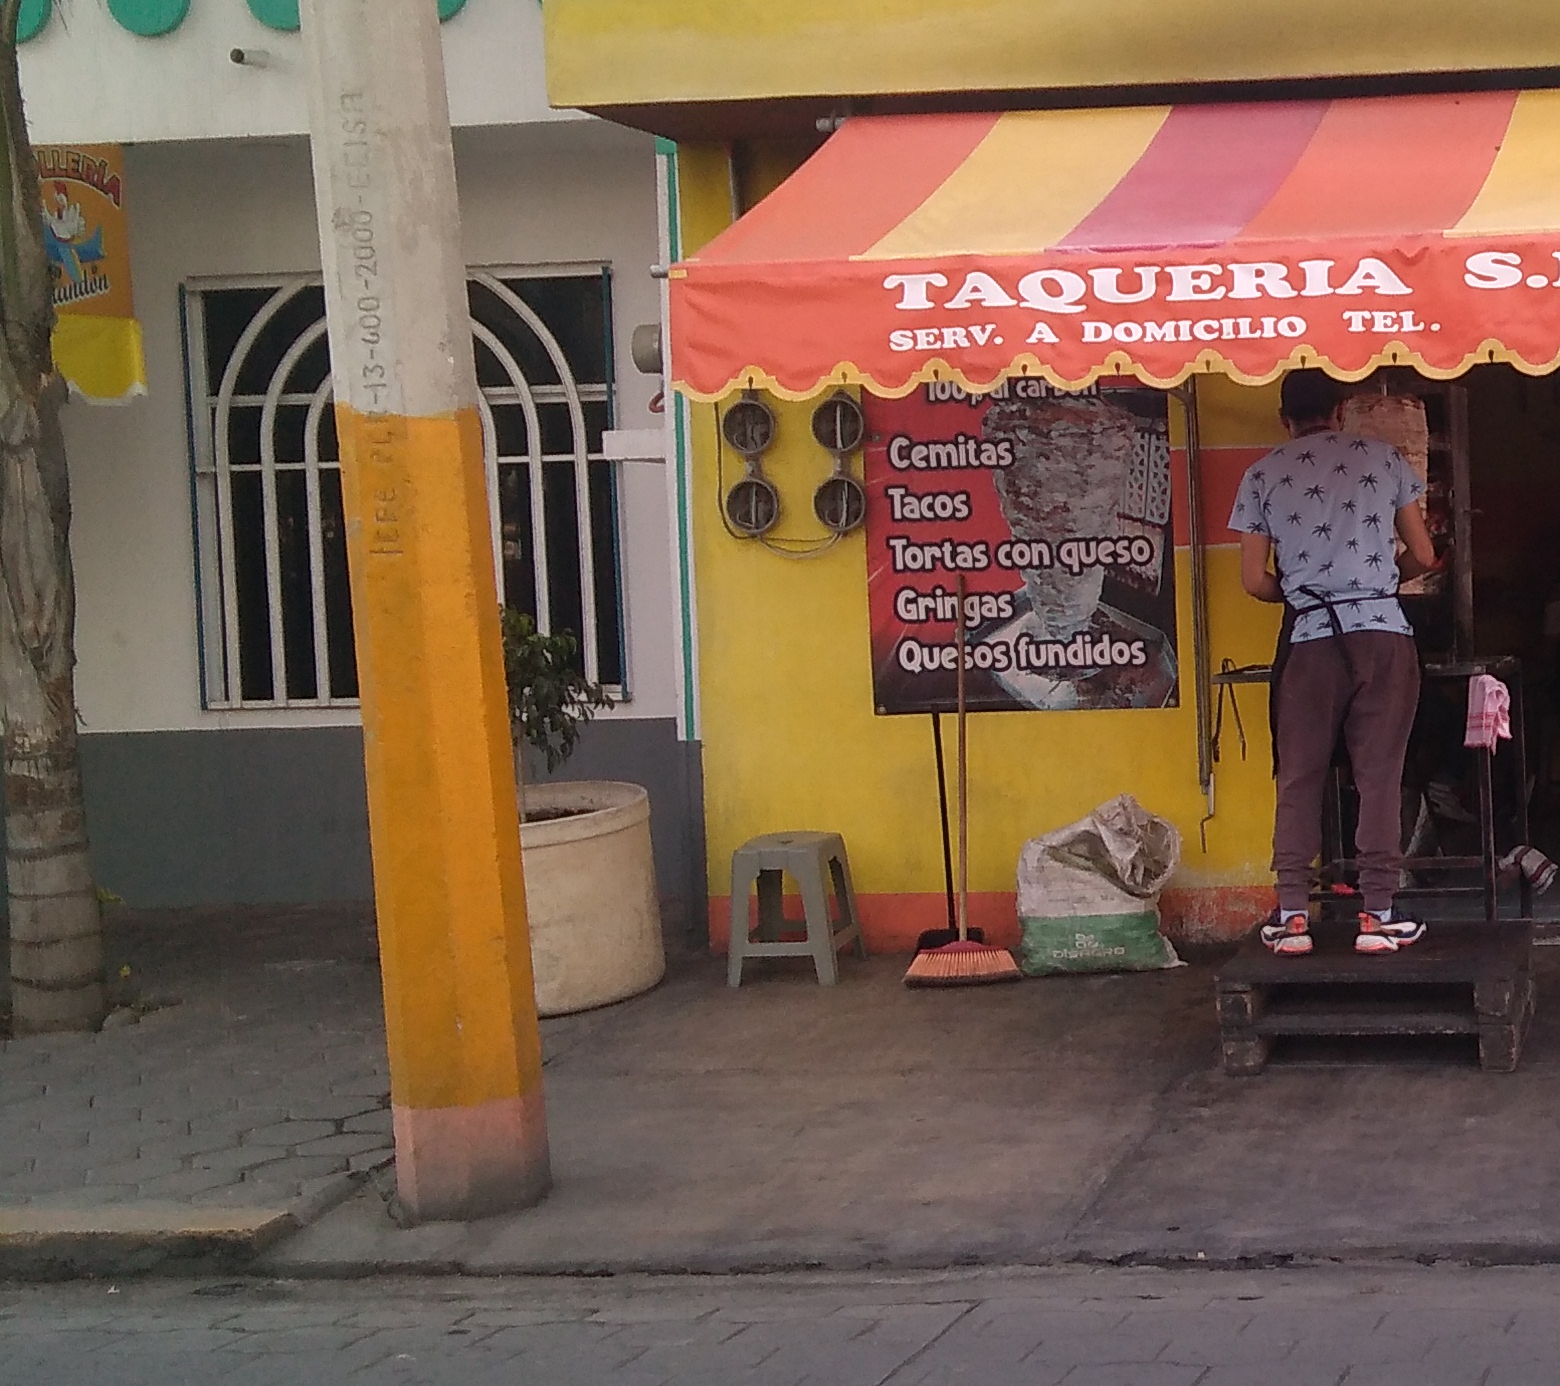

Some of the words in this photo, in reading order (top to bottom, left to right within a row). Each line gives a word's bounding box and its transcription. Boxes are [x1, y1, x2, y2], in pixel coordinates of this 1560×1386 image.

[882, 257, 1414, 314] TAQUERIA
[889, 322, 1005, 352] SERV.
[1025, 320, 1061, 344] A
[1081, 315, 1308, 344] DOMICILIO
[1342, 309, 1442, 334] TEL.
[889, 435, 1013, 470] Cemitas
[887, 487, 970, 521] Tacos
[889, 538, 990, 571] Tortas
[997, 540, 1051, 566] con
[1059, 538, 1151, 573] queso
[896, 588, 1014, 627] Gringas
[899, 640, 1012, 674] Quesos
[1017, 633, 1147, 667] fundidos
